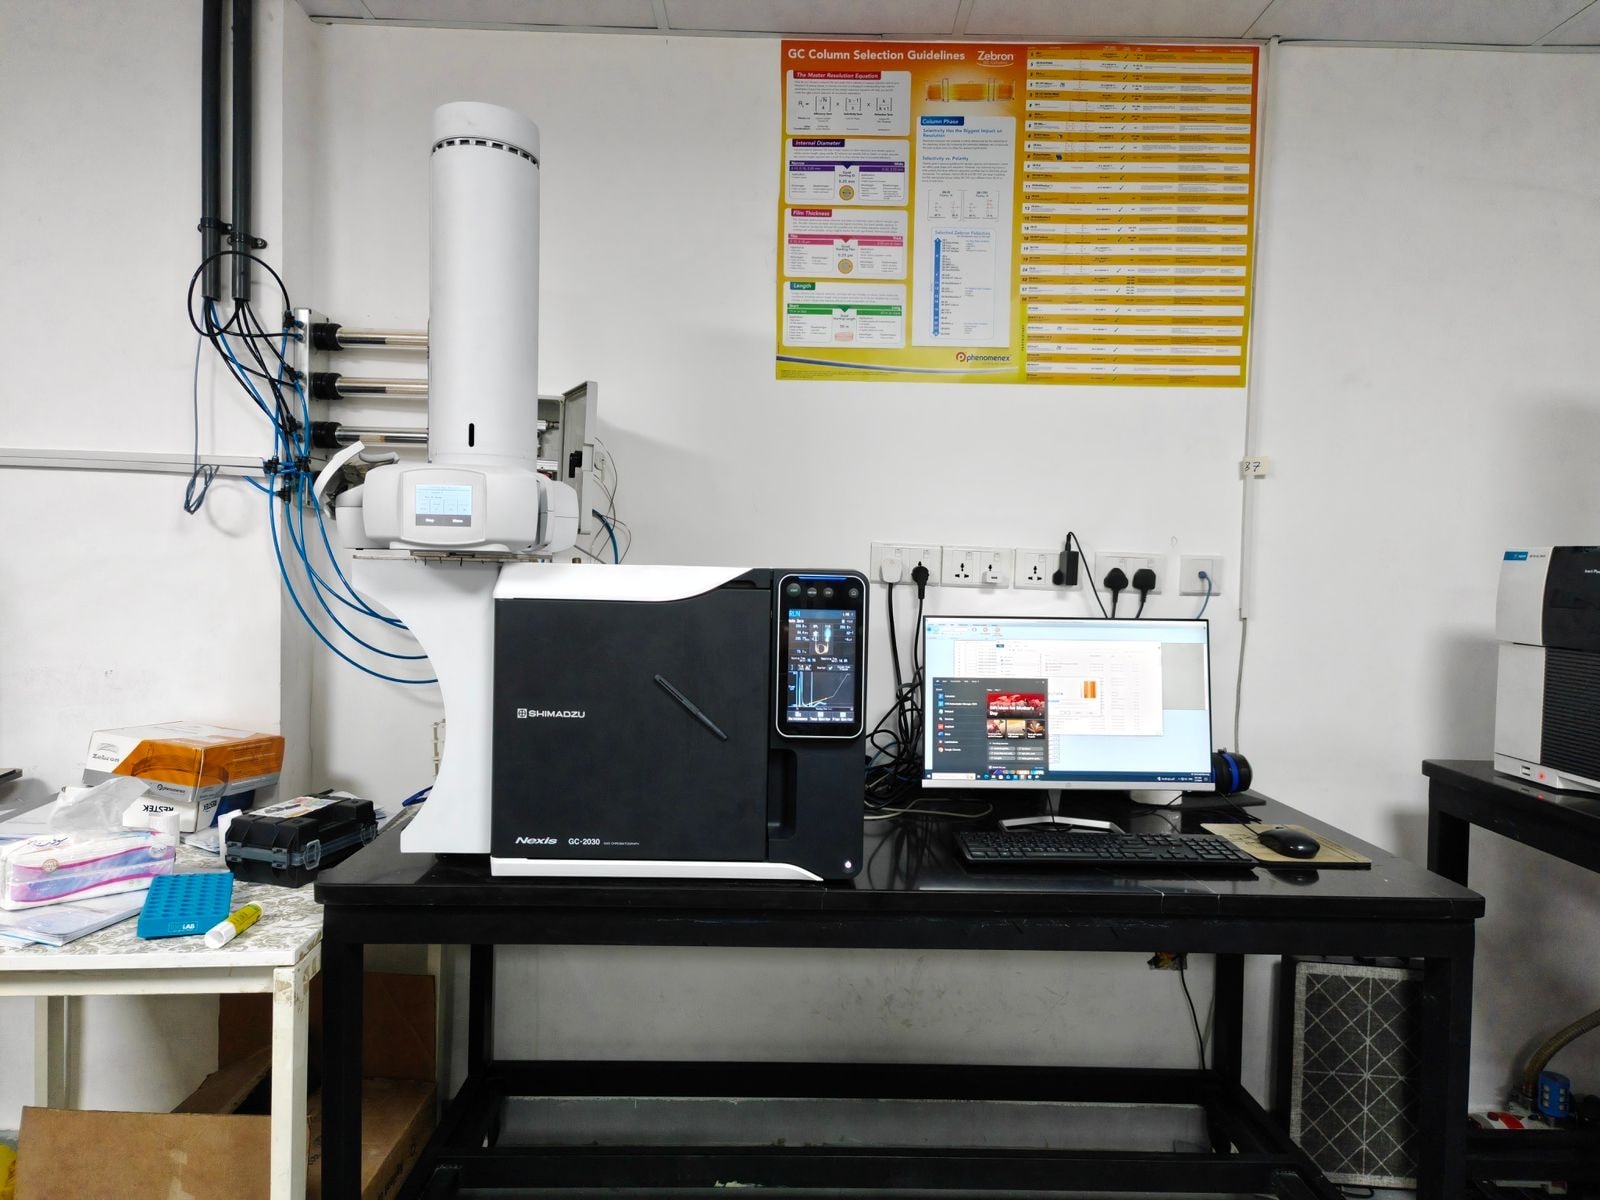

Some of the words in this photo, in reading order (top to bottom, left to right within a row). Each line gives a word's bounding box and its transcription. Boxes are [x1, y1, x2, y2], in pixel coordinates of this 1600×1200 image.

[788, 48, 805, 59] GC
[808, 48, 850, 59] Column
[854, 50, 904, 60] Selection
[908, 50, 966, 60] Guidelines
[978, 51, 1014, 60] Zebron
[966, 354, 1010, 362] phenomenex
[528, 710, 585, 718] SHIMADZU
